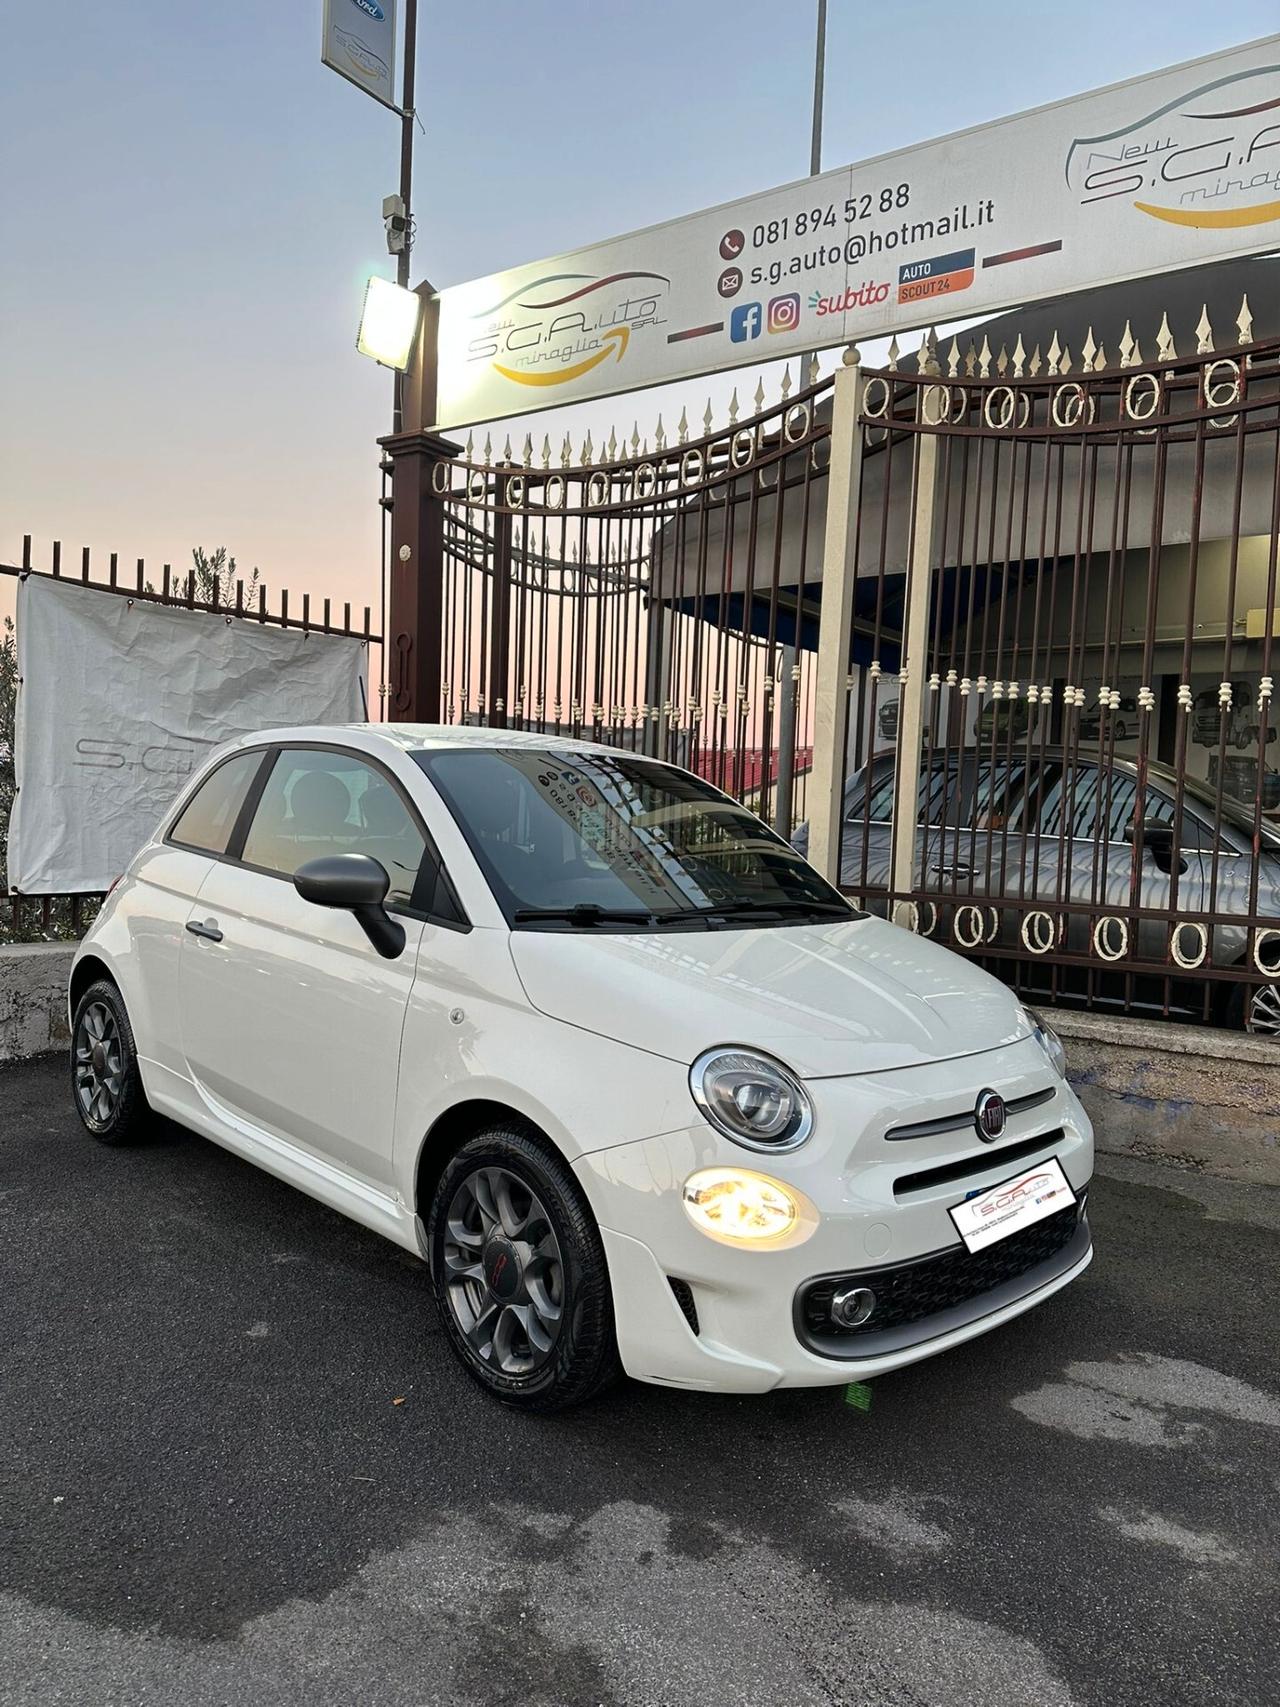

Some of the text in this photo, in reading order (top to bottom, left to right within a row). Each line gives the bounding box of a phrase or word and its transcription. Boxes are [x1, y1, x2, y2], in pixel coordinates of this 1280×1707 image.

[1087, 137, 1179, 170] New
[753, 183, 910, 248] 081 894 52 88
[750, 199, 995, 286] s.g.auto@hotmail.it
[902, 262, 932, 281] AUTO
[816, 280, 892, 317] subito
[515, 336, 603, 368] miraglia
